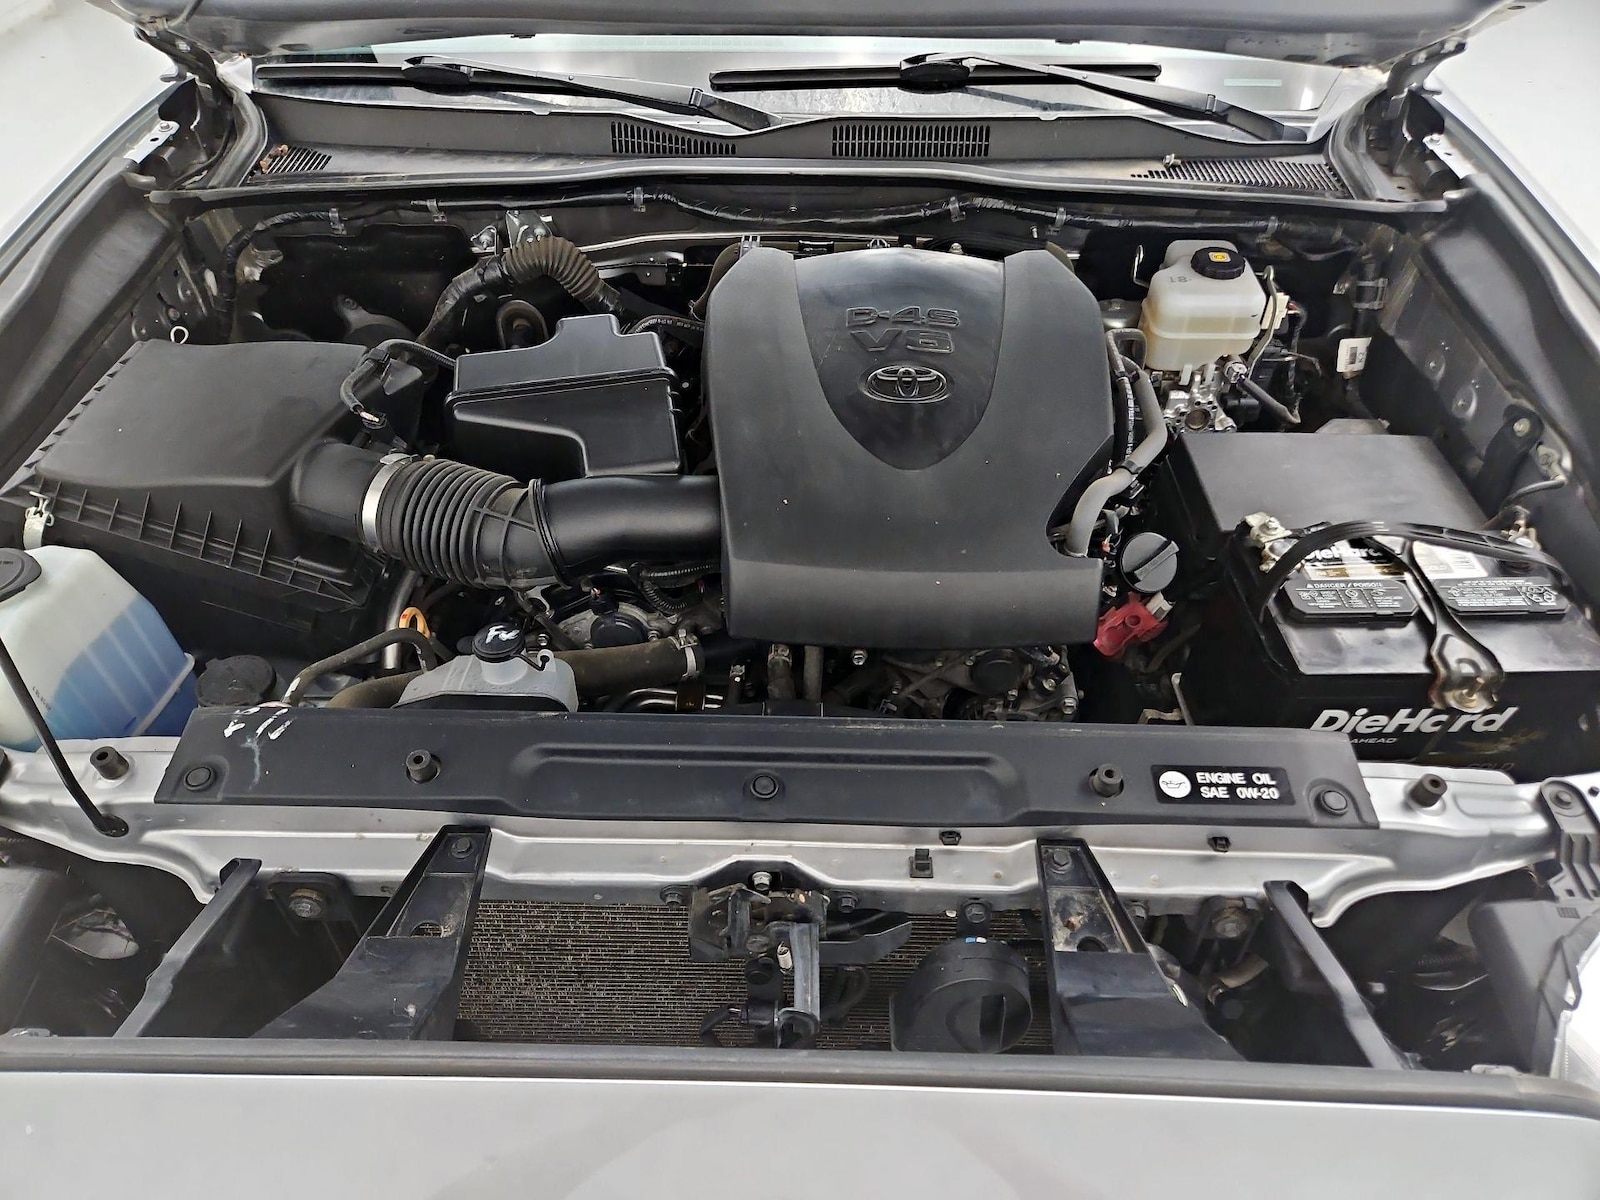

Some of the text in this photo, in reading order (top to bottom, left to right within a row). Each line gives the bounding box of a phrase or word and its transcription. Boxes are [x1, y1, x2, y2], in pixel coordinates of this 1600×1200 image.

[850, 328, 954, 354] V6
[1310, 707, 1519, 734] DieHard
[1196, 772, 1276, 785] ENGINE OIL
[1201, 787, 1280, 800] SAE 0W-20
